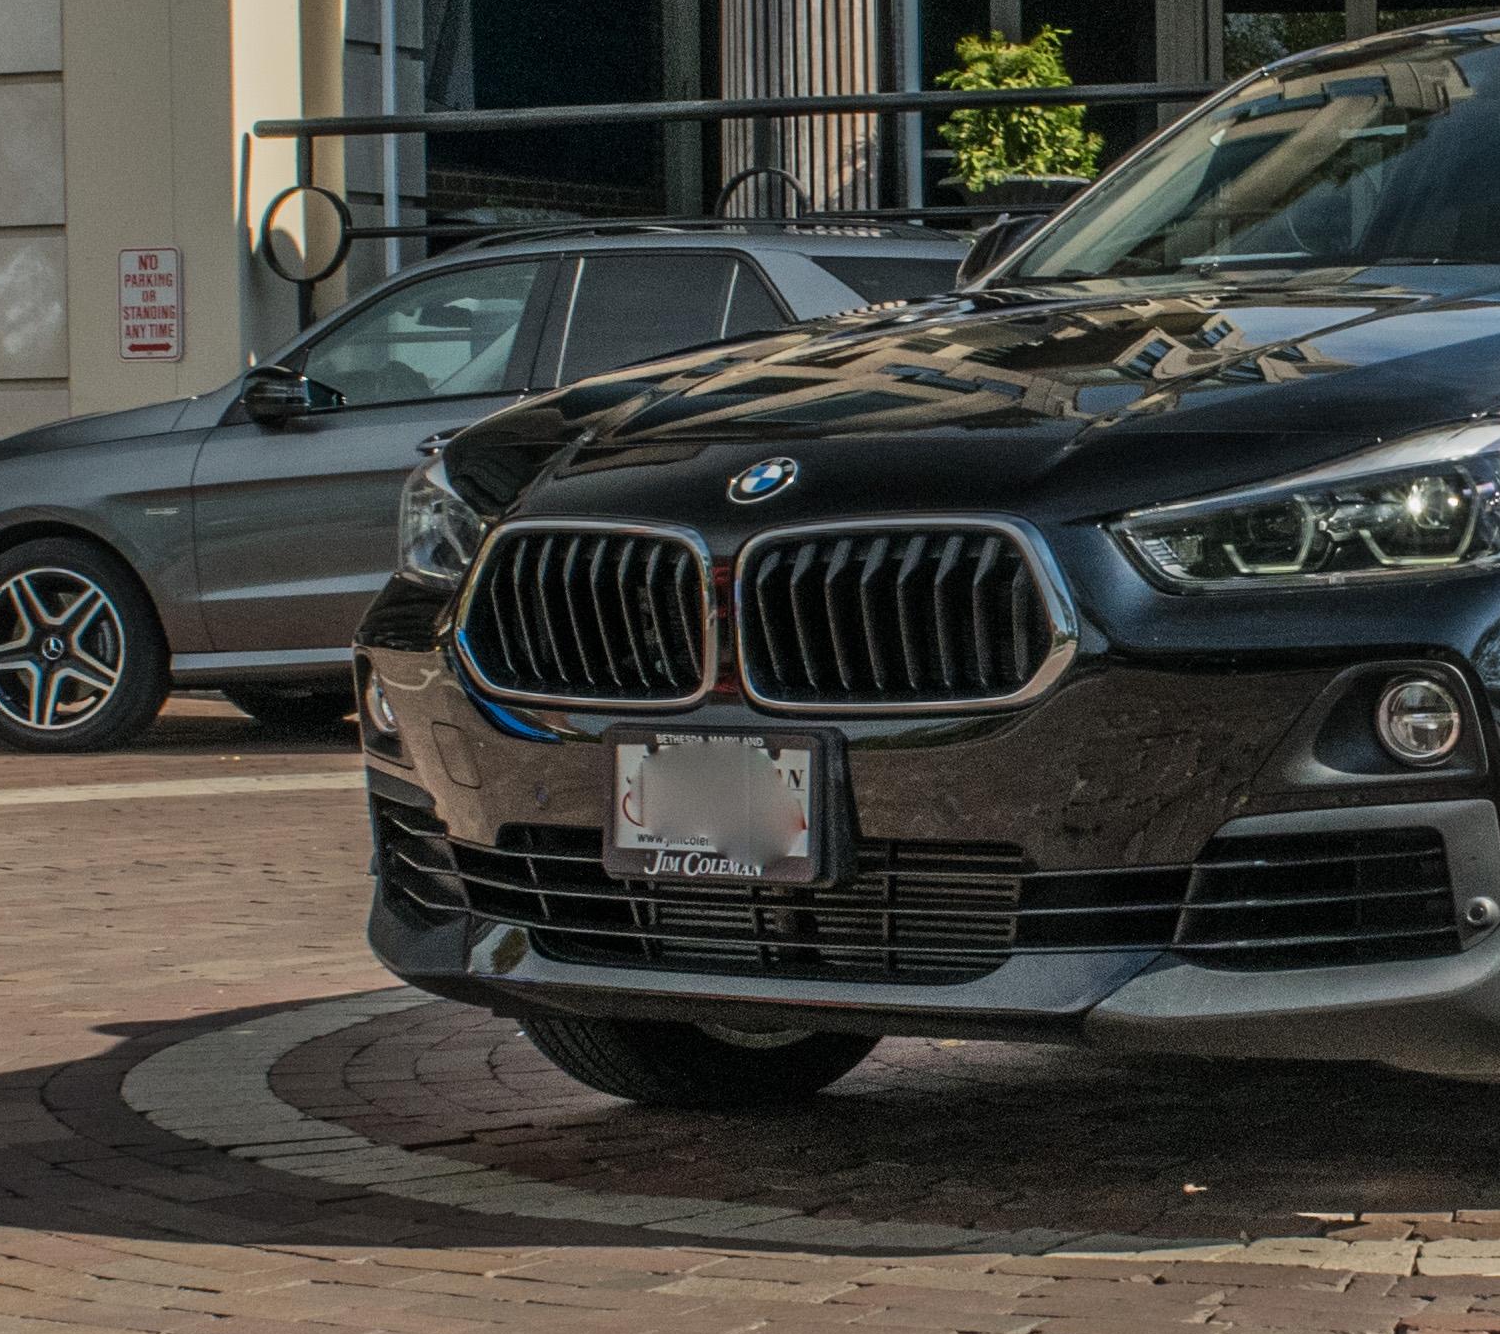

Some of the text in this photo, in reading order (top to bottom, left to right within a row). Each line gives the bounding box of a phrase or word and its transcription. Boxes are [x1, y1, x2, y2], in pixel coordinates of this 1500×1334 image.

[138, 254, 159, 270] NO
[124, 273, 173, 287] PARKING
[141, 290, 157, 303] OR
[123, 306, 176, 320] STANDING
[644, 850, 763, 877] JIM COLEMAN
